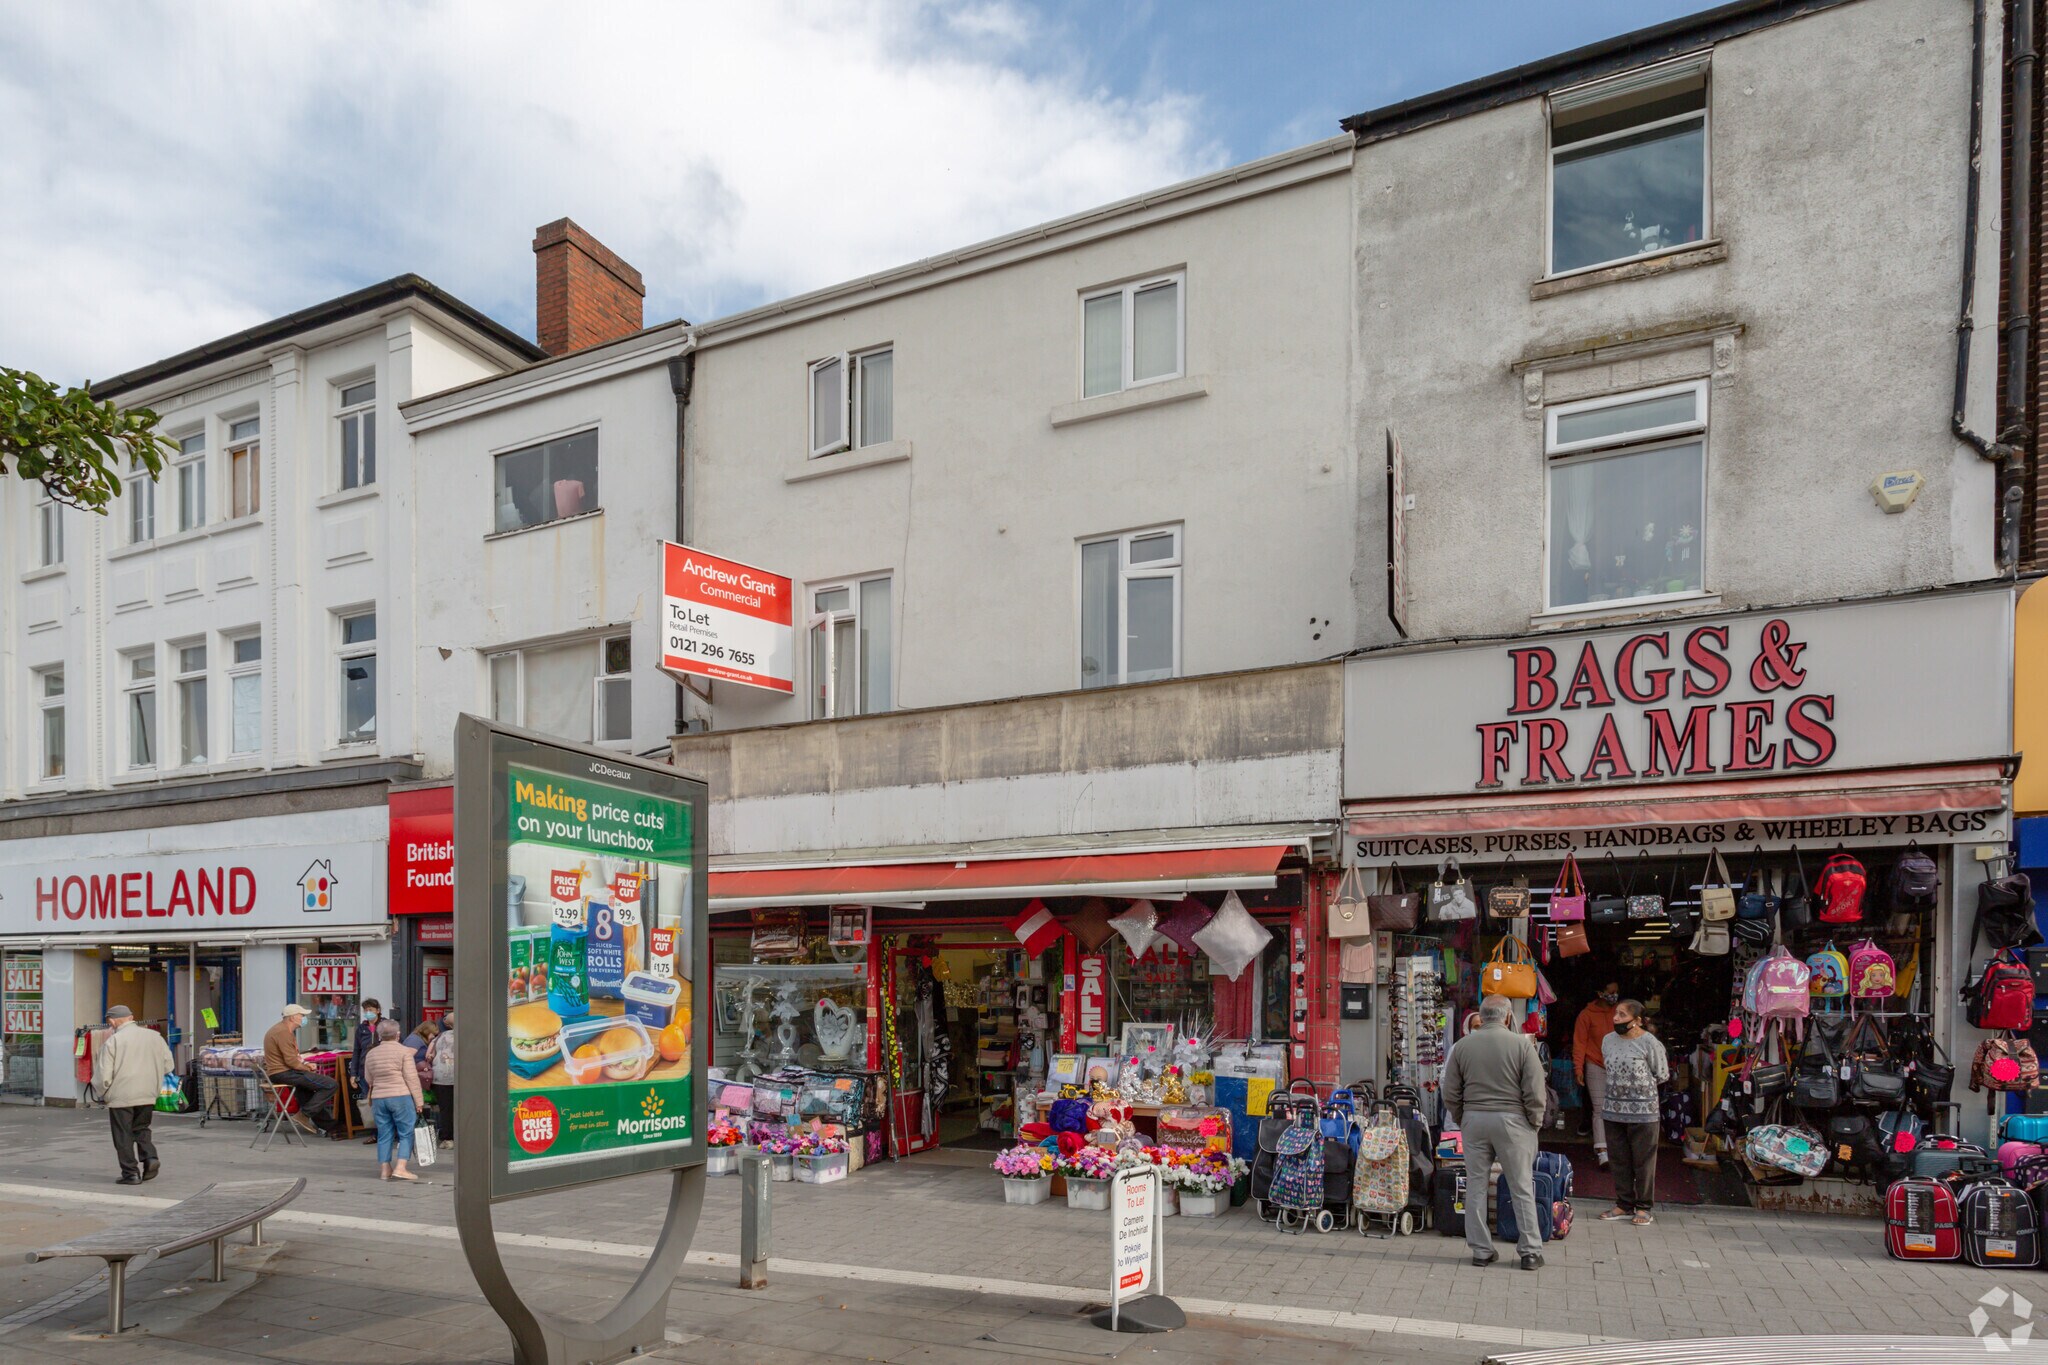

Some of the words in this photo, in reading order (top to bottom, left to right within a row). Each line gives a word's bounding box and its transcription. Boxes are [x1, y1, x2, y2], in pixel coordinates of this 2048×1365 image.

[683, 558, 738, 586] Andrew
[740, 574, 776, 597] Grant
[700, 582, 761, 608] Commercial
[670, 604, 686, 620] To
[689, 609, 710, 626] Let
[669, 621, 688, 632] Retail
[689, 625, 718, 639] Premises
[670, 636, 697, 653] 0121
[701, 642, 724, 659] 296
[728, 649, 755, 666] 7655
[1507, 626, 1731, 715] BAGS
[1750, 619, 1807, 693] &
[1475, 695, 1836, 788] FRAMES
[588, 762, 631, 780] JCDecaux
[516, 780, 588, 822] Making
[592, 803, 630, 824] price
[633, 812, 664, 830] cuts
[517, 816, 540, 833] on
[545, 820, 583, 839] your
[587, 824, 654, 853] lunchbox
[1356, 835, 1478, 857] SUITCASES,
[1484, 832, 1578, 852] PURSES,
[1584, 824, 1726, 849] HANDBAGS
[1734, 822, 1755, 841] &
[1762, 815, 1901, 841] WHEELEY
[1905, 811, 1987, 834] BAGS
[407, 840, 454, 862] British
[554, 875, 577, 887] PRICE
[617, 877, 636, 889] PRICE
[36, 866, 257, 922] HOMELAND
[556, 886, 575, 897] CUT
[619, 888, 635, 898] CUT
[554, 907, 578, 920] £2.99
[619, 908, 635, 922] 99p
[595, 909, 612, 940] 8
[653, 932, 671, 943] PRICE
[557, 948, 573, 959] JOHN
[603, 948, 622, 957] WHITE
[655, 942, 669, 952] CUT
[306, 958, 332, 966] CLOSING
[334, 958, 353, 966] DOWN
[559, 957, 575, 967] WEST
[587, 956, 622, 969] ROLLS
[654, 962, 670, 973] £1.75
[8, 970, 41, 990] SALE
[307, 967, 354, 991] SALE
[1146, 972, 1177, 983] SALE
[1081, 958, 1102, 1032] SALE
[8, 1011, 41, 1031] SALE
[522, 1109, 552, 1120] MAKING
[522, 1117, 552, 1131] PRICE
[617, 1113, 686, 1136] Morrisons
[523, 1129, 553, 1142] CUTS
[1126, 1184, 1146, 1195] Rooms
[1127, 1198, 1135, 1208] To
[1136, 1196, 1145, 1206] Let
[1123, 1215, 1144, 1226] Camere
[1119, 1230, 1127, 1240] De
